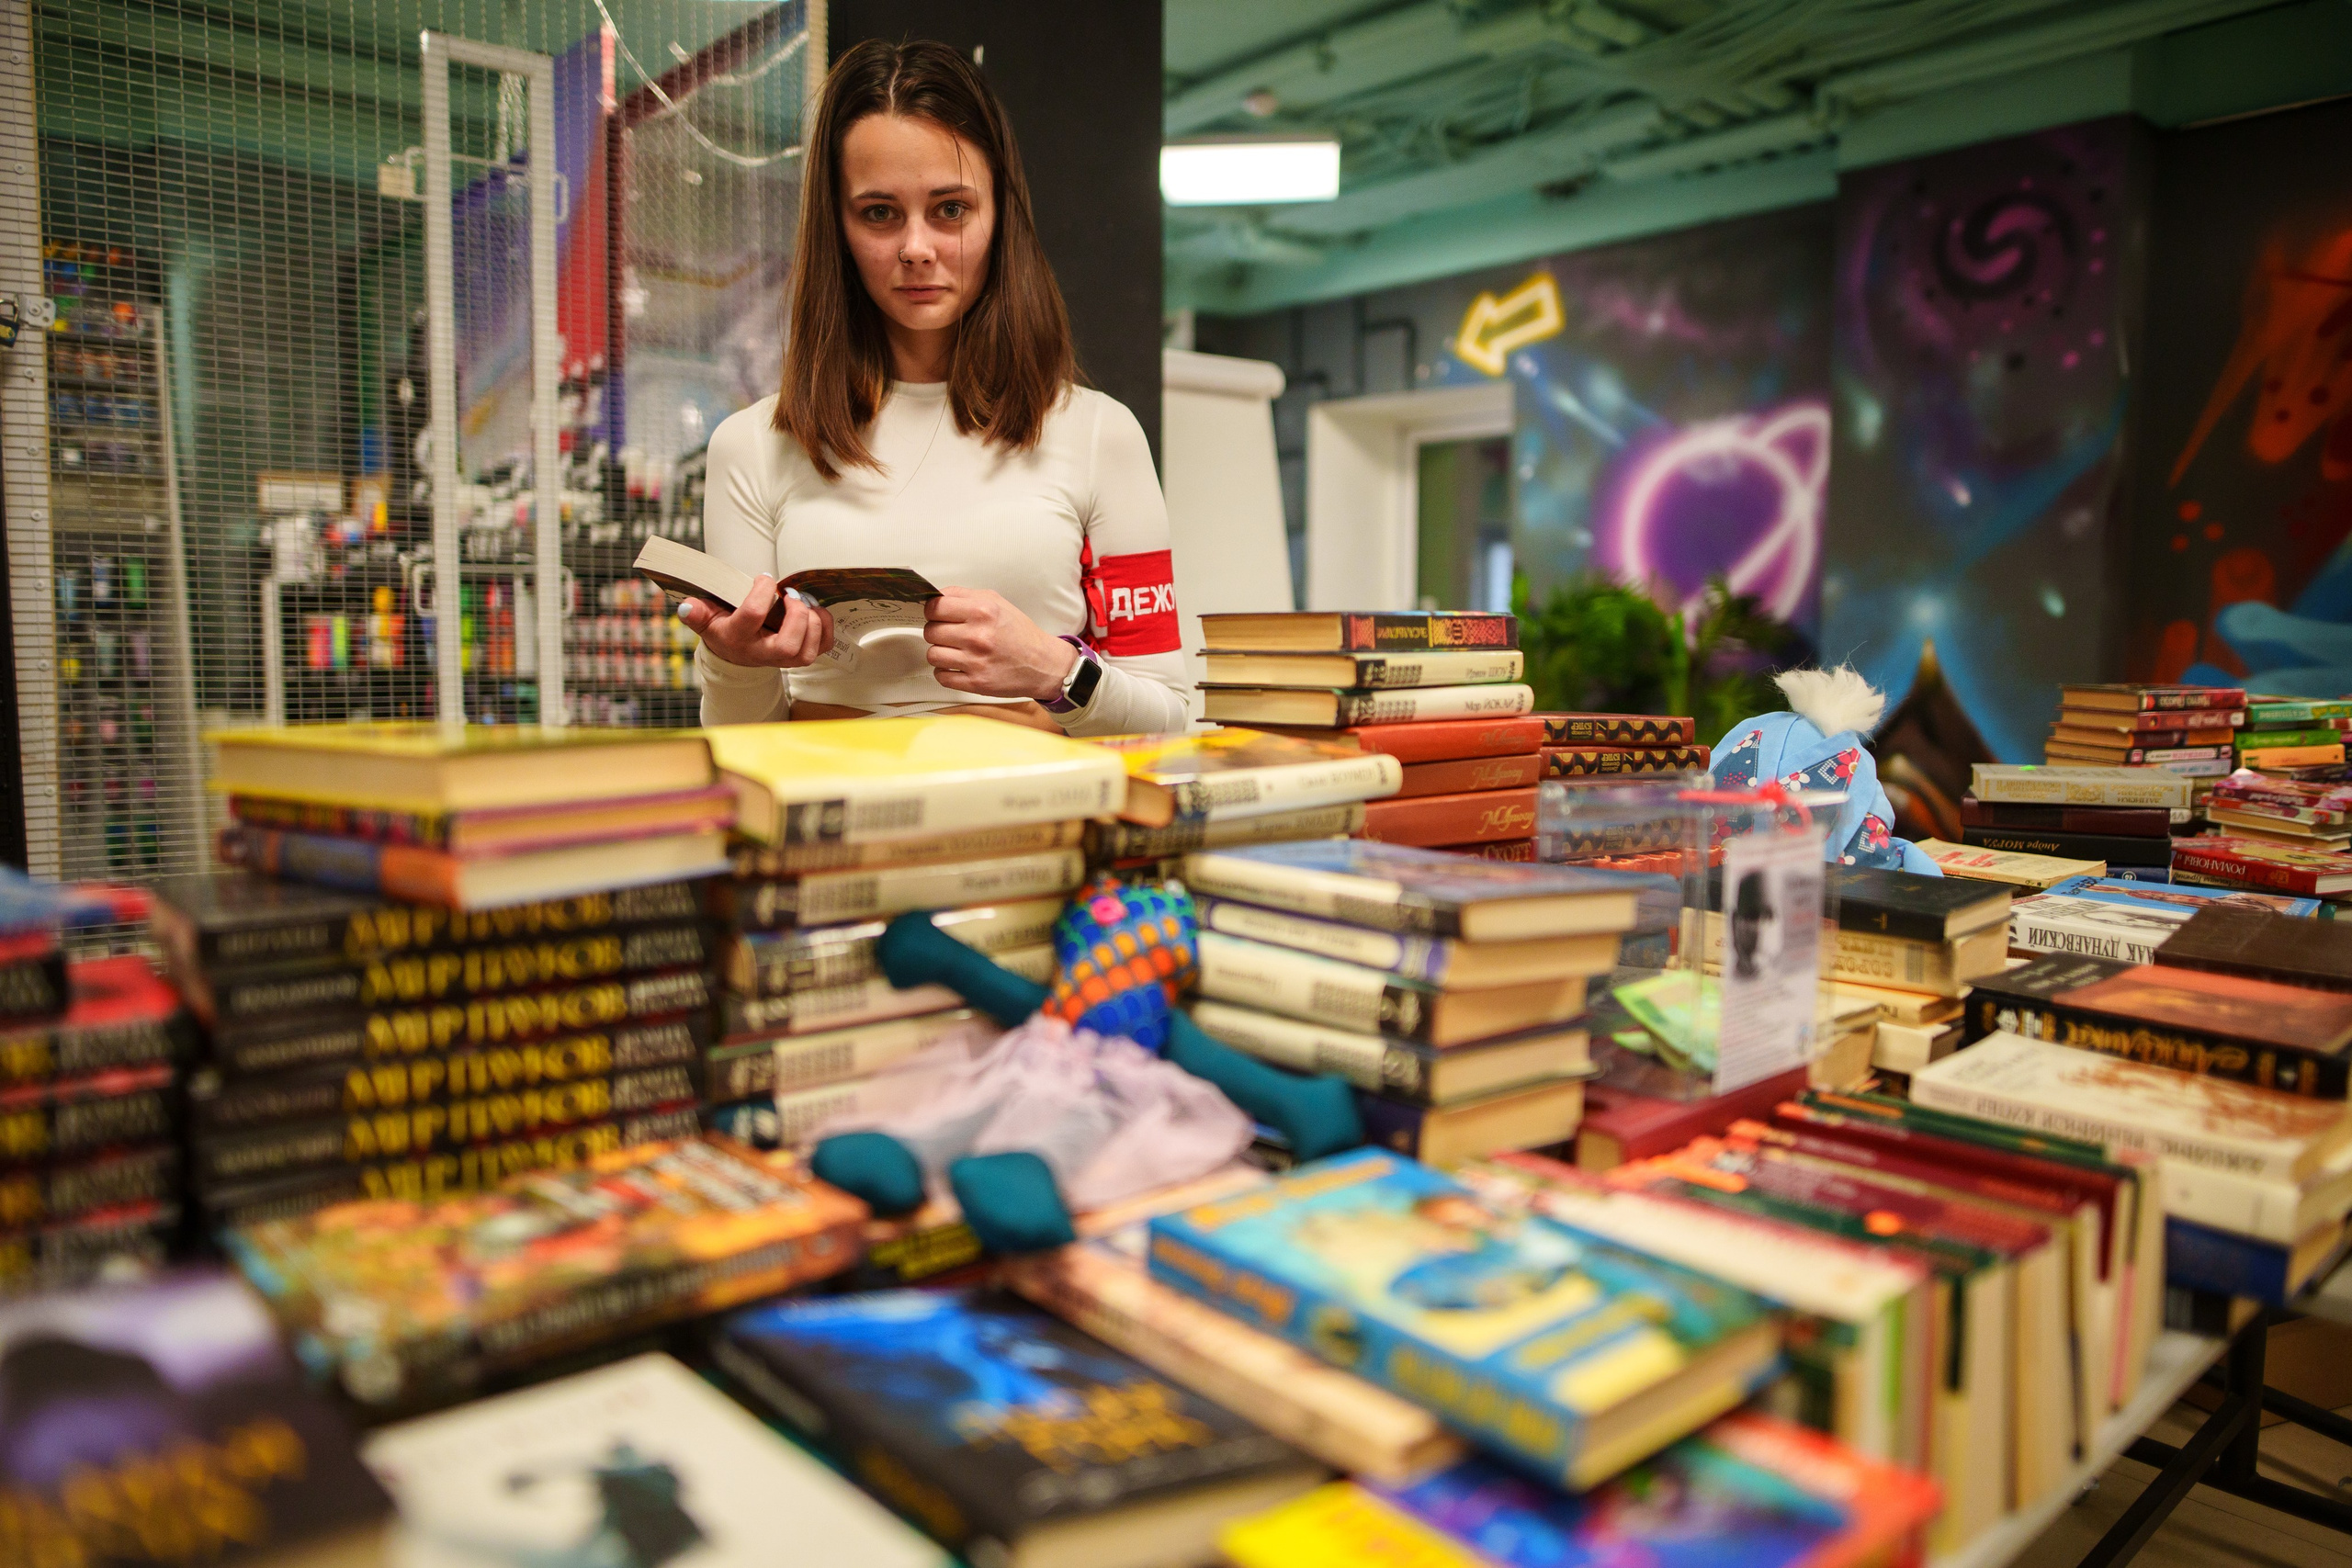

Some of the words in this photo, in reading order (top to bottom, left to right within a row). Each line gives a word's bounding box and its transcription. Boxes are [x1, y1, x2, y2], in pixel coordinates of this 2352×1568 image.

[2026, 839, 2061, 852] Андре
[2183, 854, 2246, 876] РОМАНОВЫ
[2028, 928, 2120, 960] ДУНАЕВСКИЙ
